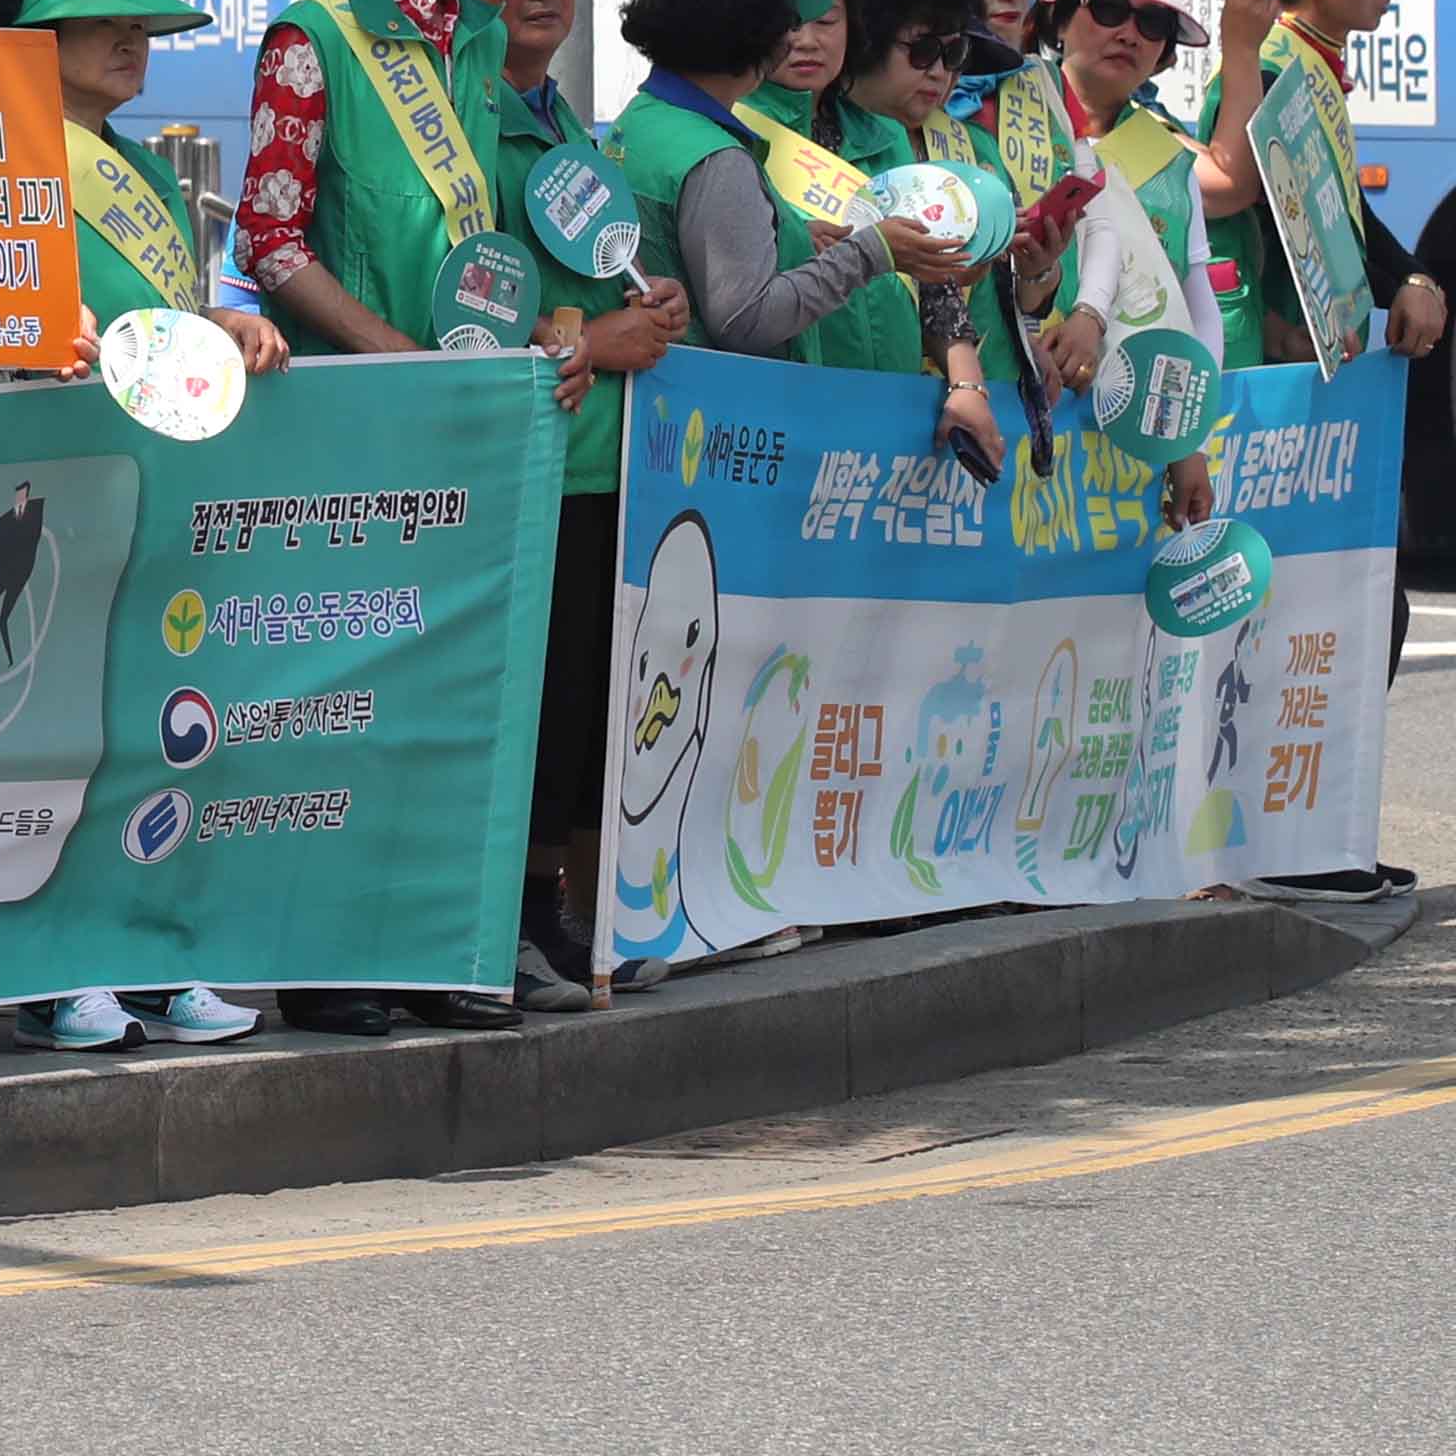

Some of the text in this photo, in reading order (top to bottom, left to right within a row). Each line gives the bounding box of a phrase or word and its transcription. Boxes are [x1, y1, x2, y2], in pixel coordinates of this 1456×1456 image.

[371, 38, 429, 105] 인천
[1340, 33, 1429, 103] 치타운
[16, 177, 66, 229] 끄기
[703, 424, 787, 488] 새마을운동
[1234, 420, 1360, 513] 동참합시다!
[190, 488, 468, 556] 절전캠페인시민단체협의회
[209, 586, 425, 646] 새마을운동중앙회
[1286, 631, 1338, 676] 가까운
[223, 690, 375, 746] 산업통상자원부
[1278, 686, 1331, 731] 거리는
[809, 702, 884, 781] 플러그
[1262, 741, 1324, 814] 걷기
[196, 788, 352, 844] 한국에너지공단
[814, 789, 864, 867] 뽑기
